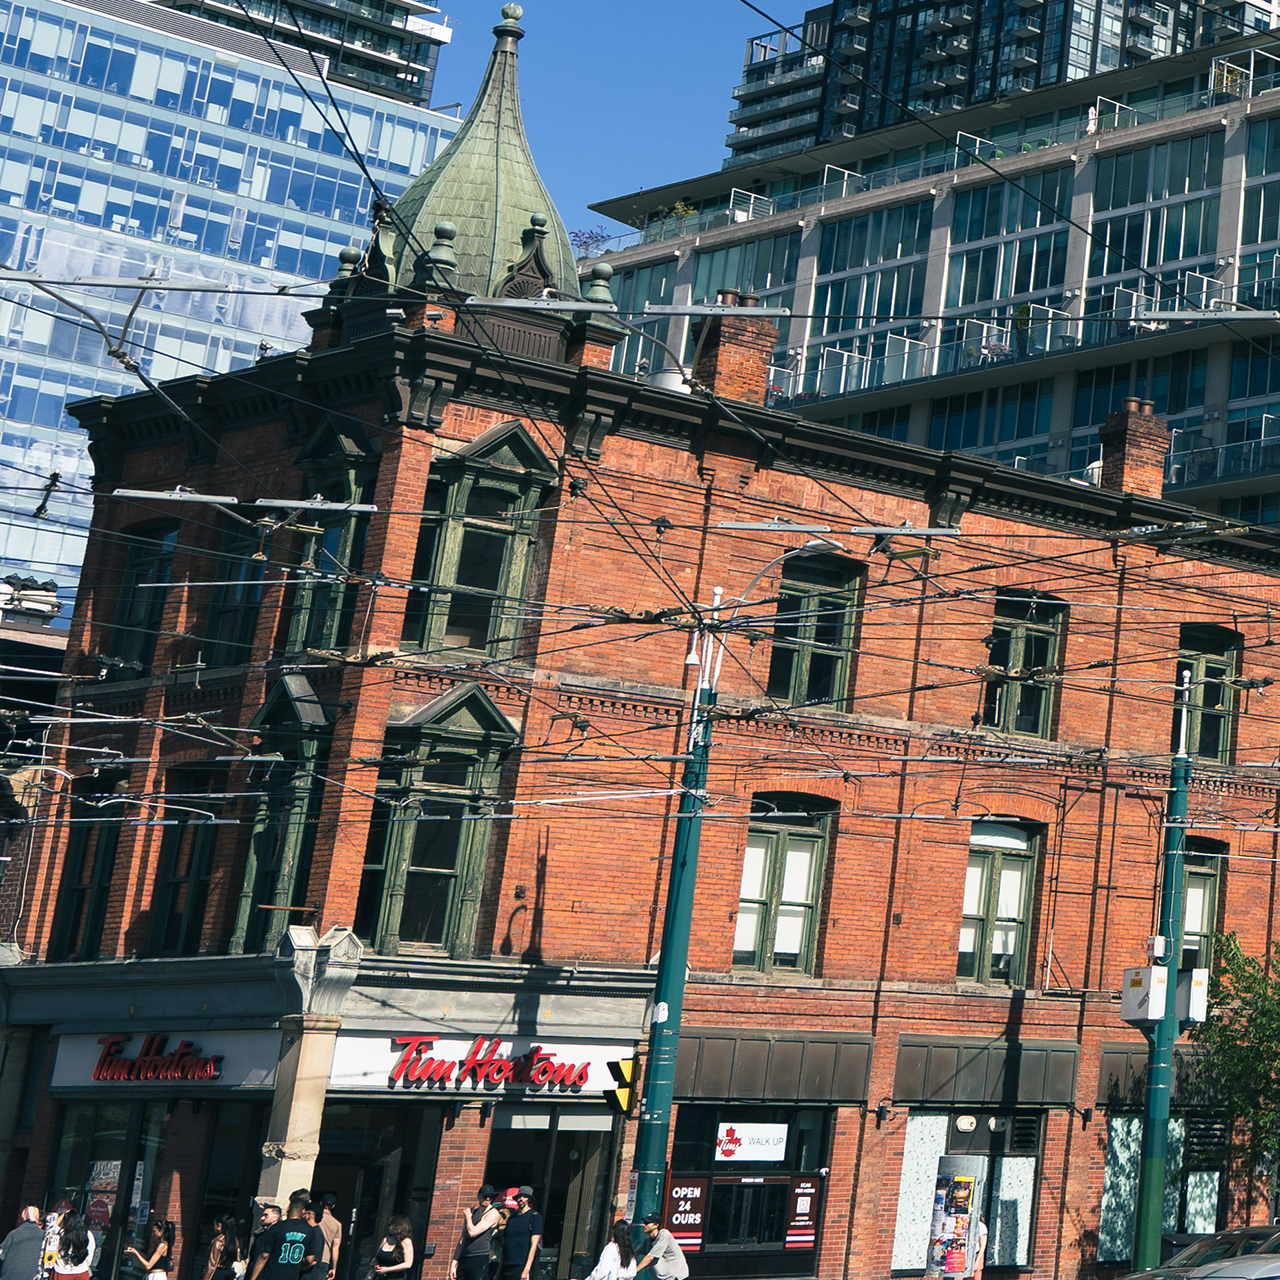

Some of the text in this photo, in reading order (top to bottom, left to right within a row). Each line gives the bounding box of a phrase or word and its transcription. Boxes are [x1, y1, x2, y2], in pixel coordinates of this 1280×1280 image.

[91, 1033, 217, 1081] Tim Hortons
[391, 1034, 592, 1086] Tim Hortons
[719, 1135, 784, 1151] Tims WALK UP
[672, 1187, 702, 1198] OPEN
[678, 1200, 692, 1212] 24
[672, 1213, 702, 1224] OURS
[278, 1243, 305, 1264] 10
